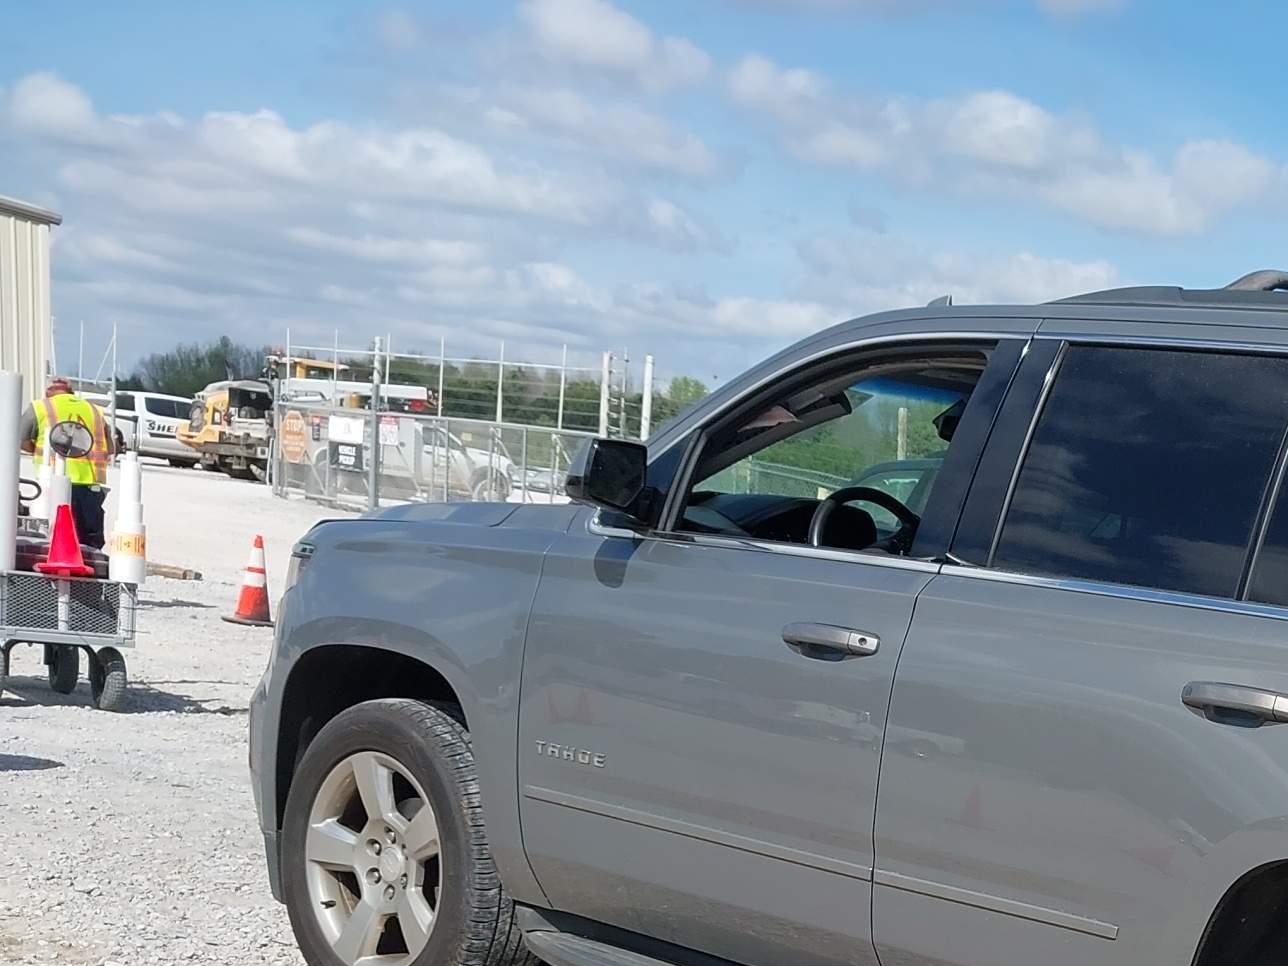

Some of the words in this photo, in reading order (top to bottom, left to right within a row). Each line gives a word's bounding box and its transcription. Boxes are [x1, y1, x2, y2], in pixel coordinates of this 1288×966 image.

[147, 419, 177, 433] SHE
[286, 418, 303, 432] STOP
[535, 739, 607, 768] TAHOE
